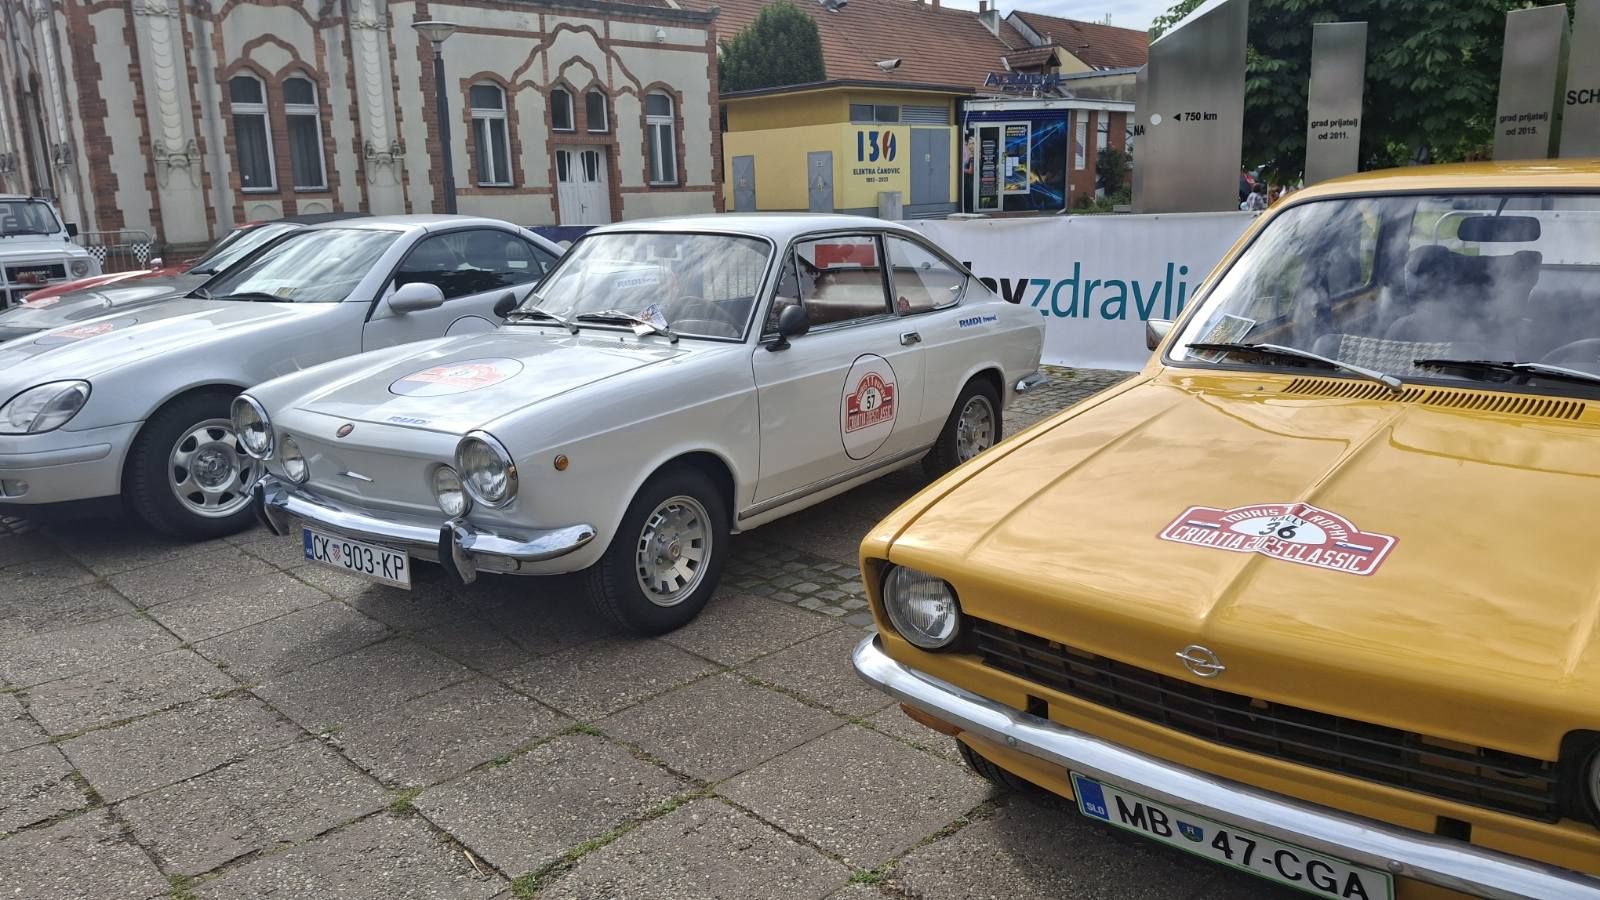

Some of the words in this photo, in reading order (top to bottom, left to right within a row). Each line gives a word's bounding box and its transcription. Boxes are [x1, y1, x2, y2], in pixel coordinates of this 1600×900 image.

[1185, 112, 1201, 121] 750
[1203, 111, 1218, 121] km
[1500, 114, 1518, 124] grad
[1311, 119, 1328, 129] grad
[1330, 118, 1358, 128] prijatelj
[1318, 131, 1328, 139] od
[1505, 127, 1516, 136] od
[857, 130, 897, 162] 130
[853, 168, 876, 176] ELEKTRA
[959, 316, 982, 328] RUDI
[866, 394, 876, 410] 57
[1270, 515, 1308, 527] RALLY
[1259, 521, 1300, 540] 36
[1171, 525, 1246, 550] CROATIA
[1282, 543, 1368, 572] CLASSIC
[313, 535, 333, 563] CK
[342, 542, 404, 580] 903-KP
[1085, 801, 1106, 816] SLO
[1115, 795, 1173, 838] MB
[1212, 830, 1370, 900] 47-CGA
